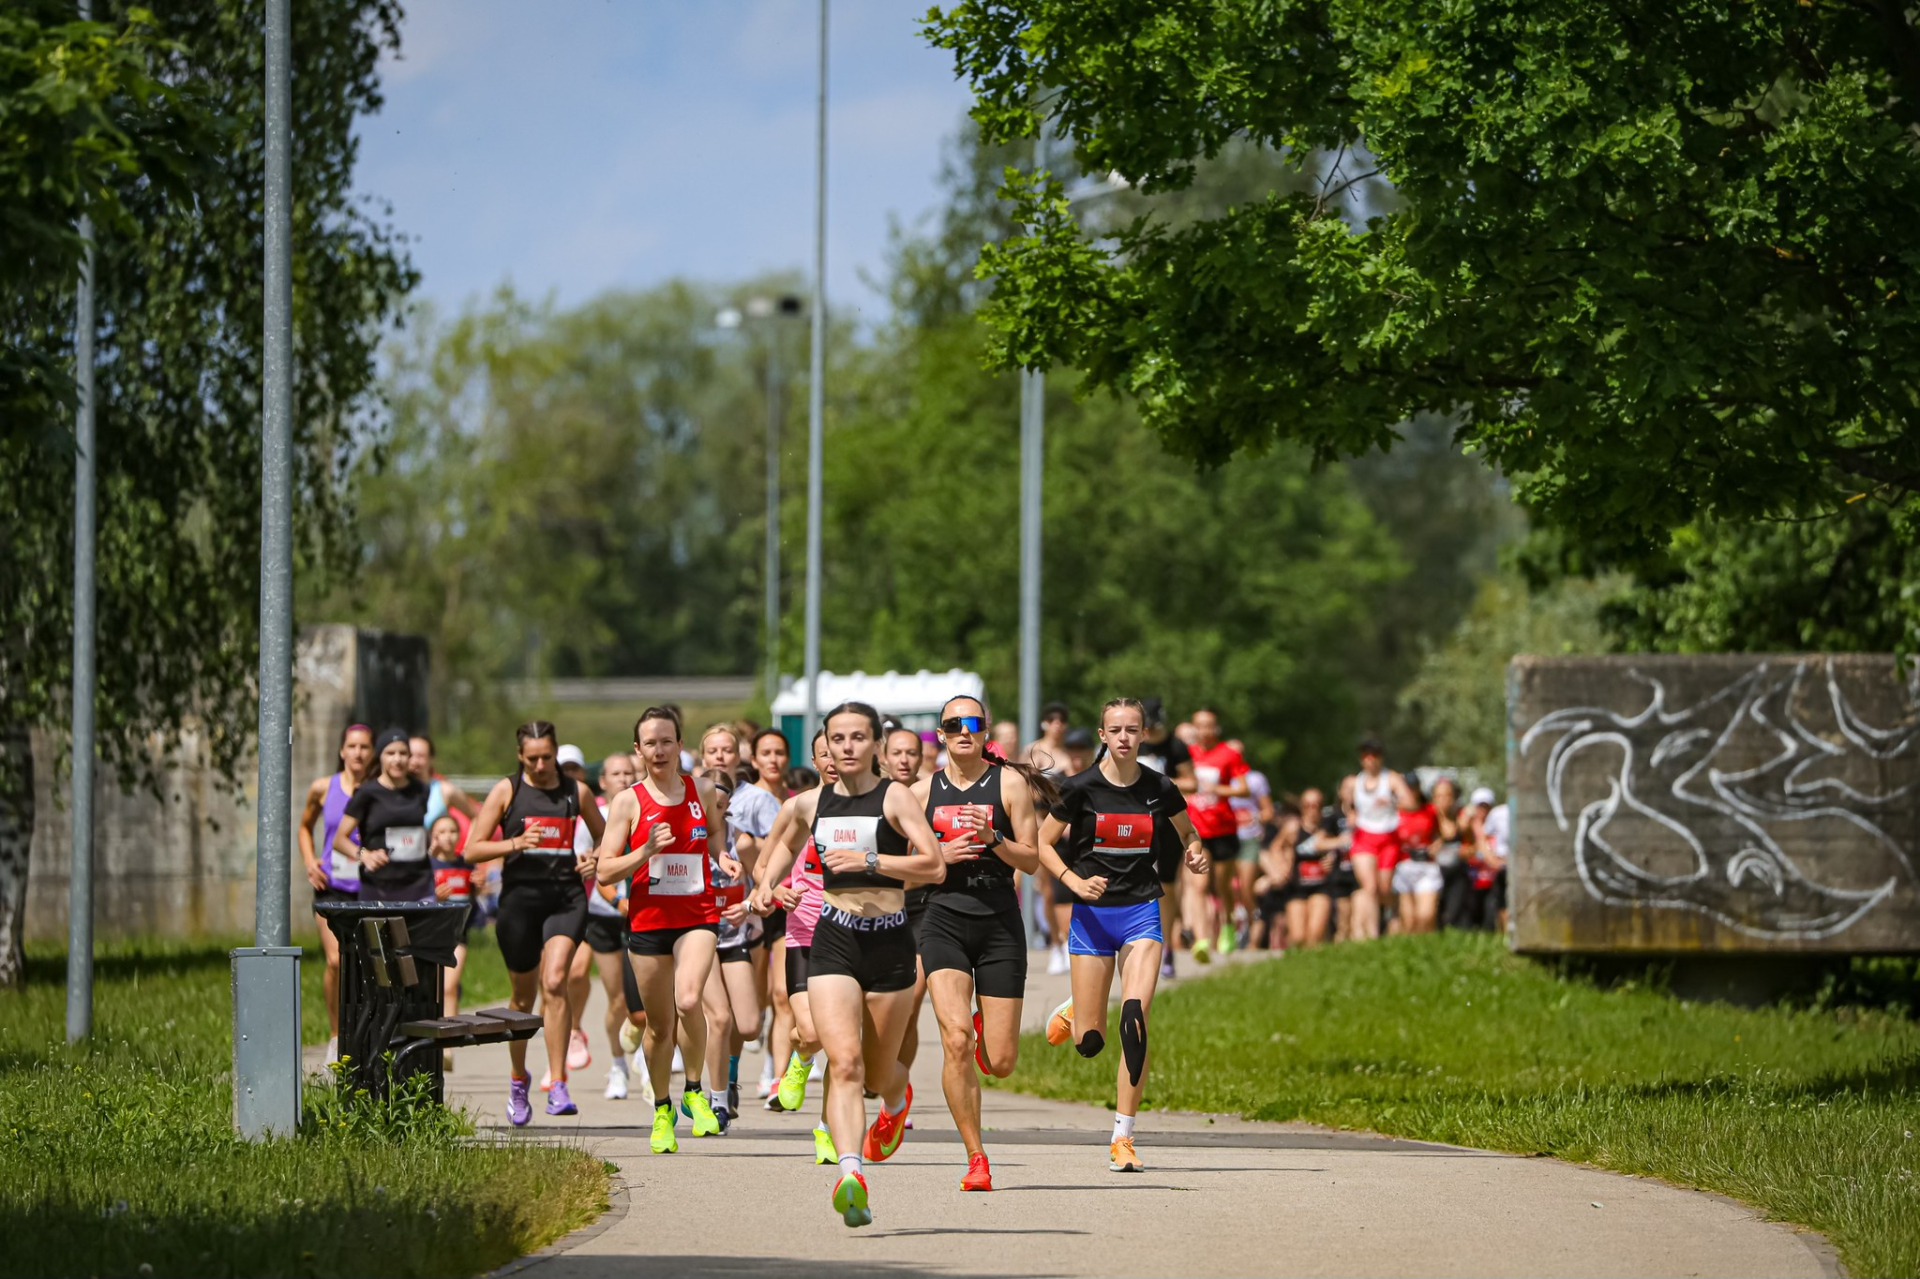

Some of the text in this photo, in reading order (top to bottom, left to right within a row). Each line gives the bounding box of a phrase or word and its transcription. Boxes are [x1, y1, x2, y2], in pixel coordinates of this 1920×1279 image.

[833, 828, 857, 843] DAINA
[1117, 824, 1133, 837] 1167
[667, 862, 688, 877] MĀRA
[832, 908, 870, 932] NIKE
[873, 910, 904, 932] PRO
